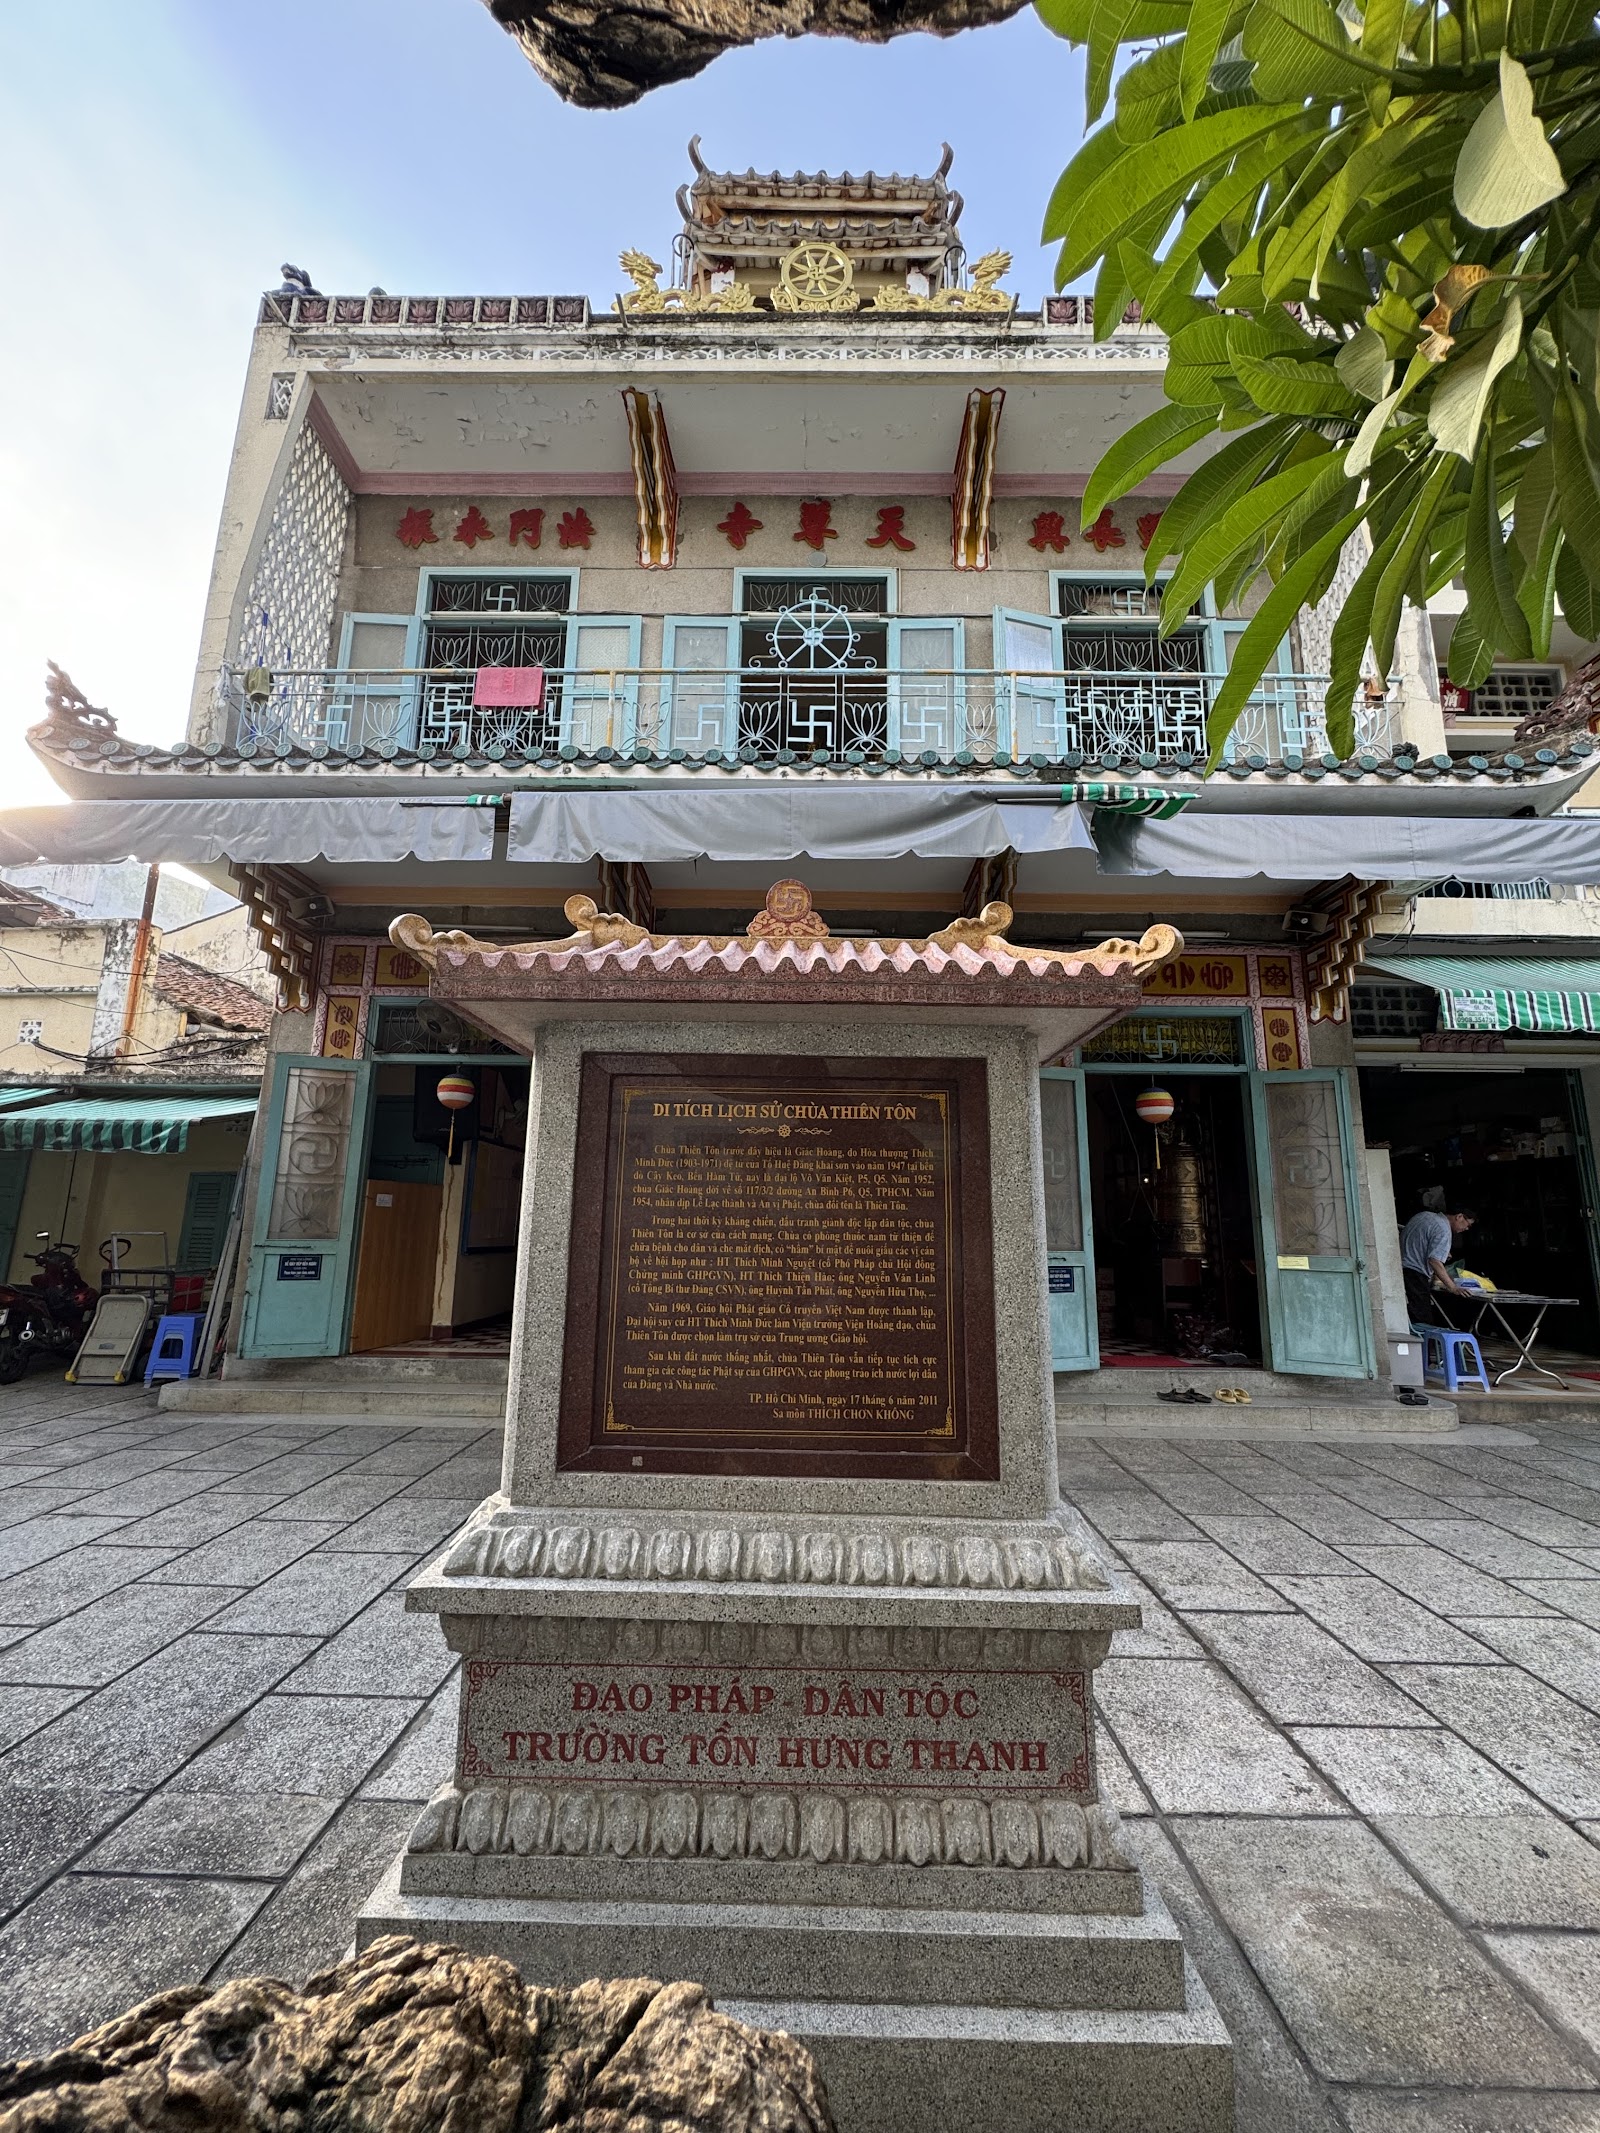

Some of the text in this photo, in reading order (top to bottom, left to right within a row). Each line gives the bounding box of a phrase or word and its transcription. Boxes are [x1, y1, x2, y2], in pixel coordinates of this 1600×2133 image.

[653, 1098, 916, 1121] DI TÍCH LỊCH SỬ CHÙA THIÊN TÔN
[661, 1270, 683, 1279] minh
[740, 1271, 754, 1280] HT
[758, 1271, 782, 1280] Thích
[838, 1272, 854, 1284] ông
[894, 1273, 911, 1282] Văn
[915, 1273, 935, 1282] Linh
[664, 1283, 673, 1293] Bí
[675, 1284, 690, 1293] thư
[748, 1285, 763, 1296] ông
[766, 1285, 793, 1296] Huỳnh
[837, 1286, 852, 1297] ông
[648, 1302, 667, 1312] Năm
[696, 1303, 716, 1312] Giáo
[758, 1304, 775, 1315] giáo
[845, 1305, 864, 1314] Nam
[892, 1305, 917, 1315] thành
[626, 1316, 640, 1327] Đại
[658, 1319, 671, 1328] suy
[687, 1317, 699, 1326] HT
[704, 1317, 727, 1326] Thích
[730, 1317, 752, 1327] Minh
[774, 1318, 789, 1327] làm
[915, 1320, 935, 1329] chùa
[626, 1330, 649, 1340] Thiên
[652, 1330, 668, 1340] Tôn
[694, 1331, 714, 1343] chọn
[716, 1331, 732, 1341] làm
[734, 1332, 747, 1343] trụ
[779, 1332, 804, 1344] Trung
[830, 1333, 850, 1343] Giáo
[648, 1351, 663, 1360] Sau
[667, 1351, 680, 1360] khi
[777, 1352, 797, 1362] chùa
[801, 1353, 824, 1362] Thiên
[829, 1353, 844, 1363] Tôn
[886, 1355, 899, 1366] tục
[903, 1354, 918, 1364] tích
[624, 1365, 644, 1374] tham
[647, 1366, 659, 1377] gia
[661, 1365, 675, 1375] các
[677, 1365, 696, 1377] công
[698, 1366, 710, 1375] tác
[808, 1367, 822, 1377] các
[824, 1368, 850, 1379] phong
[852, 1368, 869, 1377] trào
[871, 1368, 883, 1378] ích
[921, 1369, 937, 1378] dân
[664, 1379, 673, 1389] và
[675, 1380, 692, 1389] Nhà
[780, 1394, 796, 1403] Chí
[826, 1394, 846, 1406] ngày
[850, 1394, 859, 1404] 17
[861, 1395, 885, 1406] tháng
[888, 1395, 893, 1404] 6
[896, 1395, 915, 1404] năm
[918, 1395, 937, 1405] 2011
[773, 1407, 914, 1419] Sa môn THÍCH CHƠN KHÔNG
[571, 1681, 653, 1718] ĐẠO
[667, 1677, 775, 1715] PHÁP
[803, 1679, 886, 1717] DÂN
[899, 1681, 980, 1726] TỘC
[502, 1721, 1049, 1778] TRƯỜNG TỒN HƯNG THẠNH
